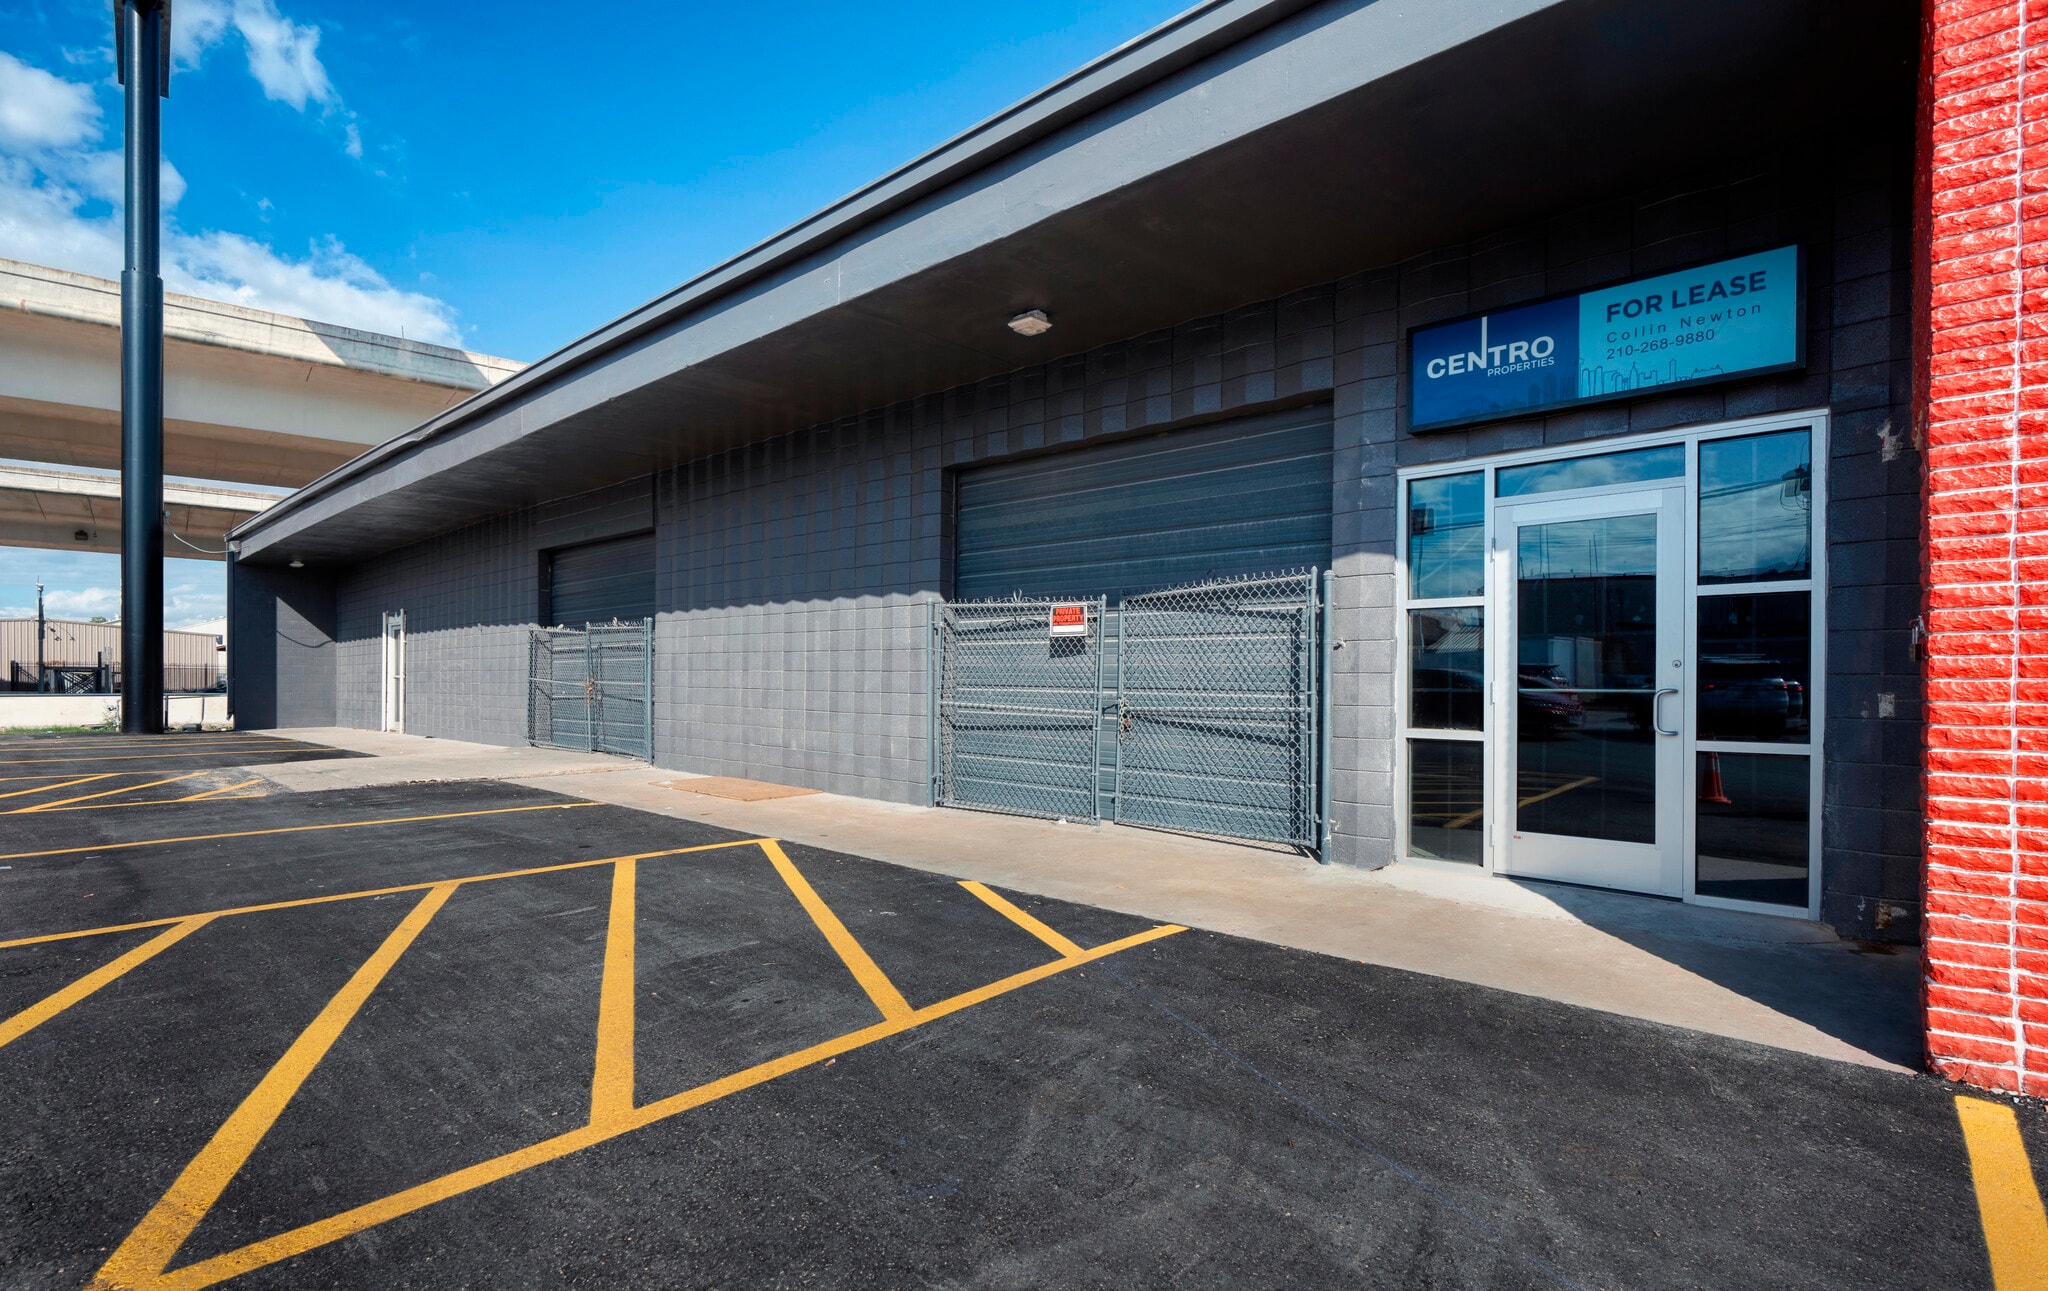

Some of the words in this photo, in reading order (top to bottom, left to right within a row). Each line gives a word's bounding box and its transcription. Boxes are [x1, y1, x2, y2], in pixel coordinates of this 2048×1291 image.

[1606, 294, 1663, 323] FOR
[1671, 270, 1767, 309] LEASE
[1606, 323, 1666, 343] Collin
[1680, 304, 1761, 329] Newton
[1426, 316, 1555, 379] CENTRO
[1606, 328, 1715, 360] 210-268-9880
[1487, 356, 1555, 377] PROPERTIES
[1052, 614, 1084, 622] PROPERTY
[1055, 607, 1081, 615] PRIVATE
